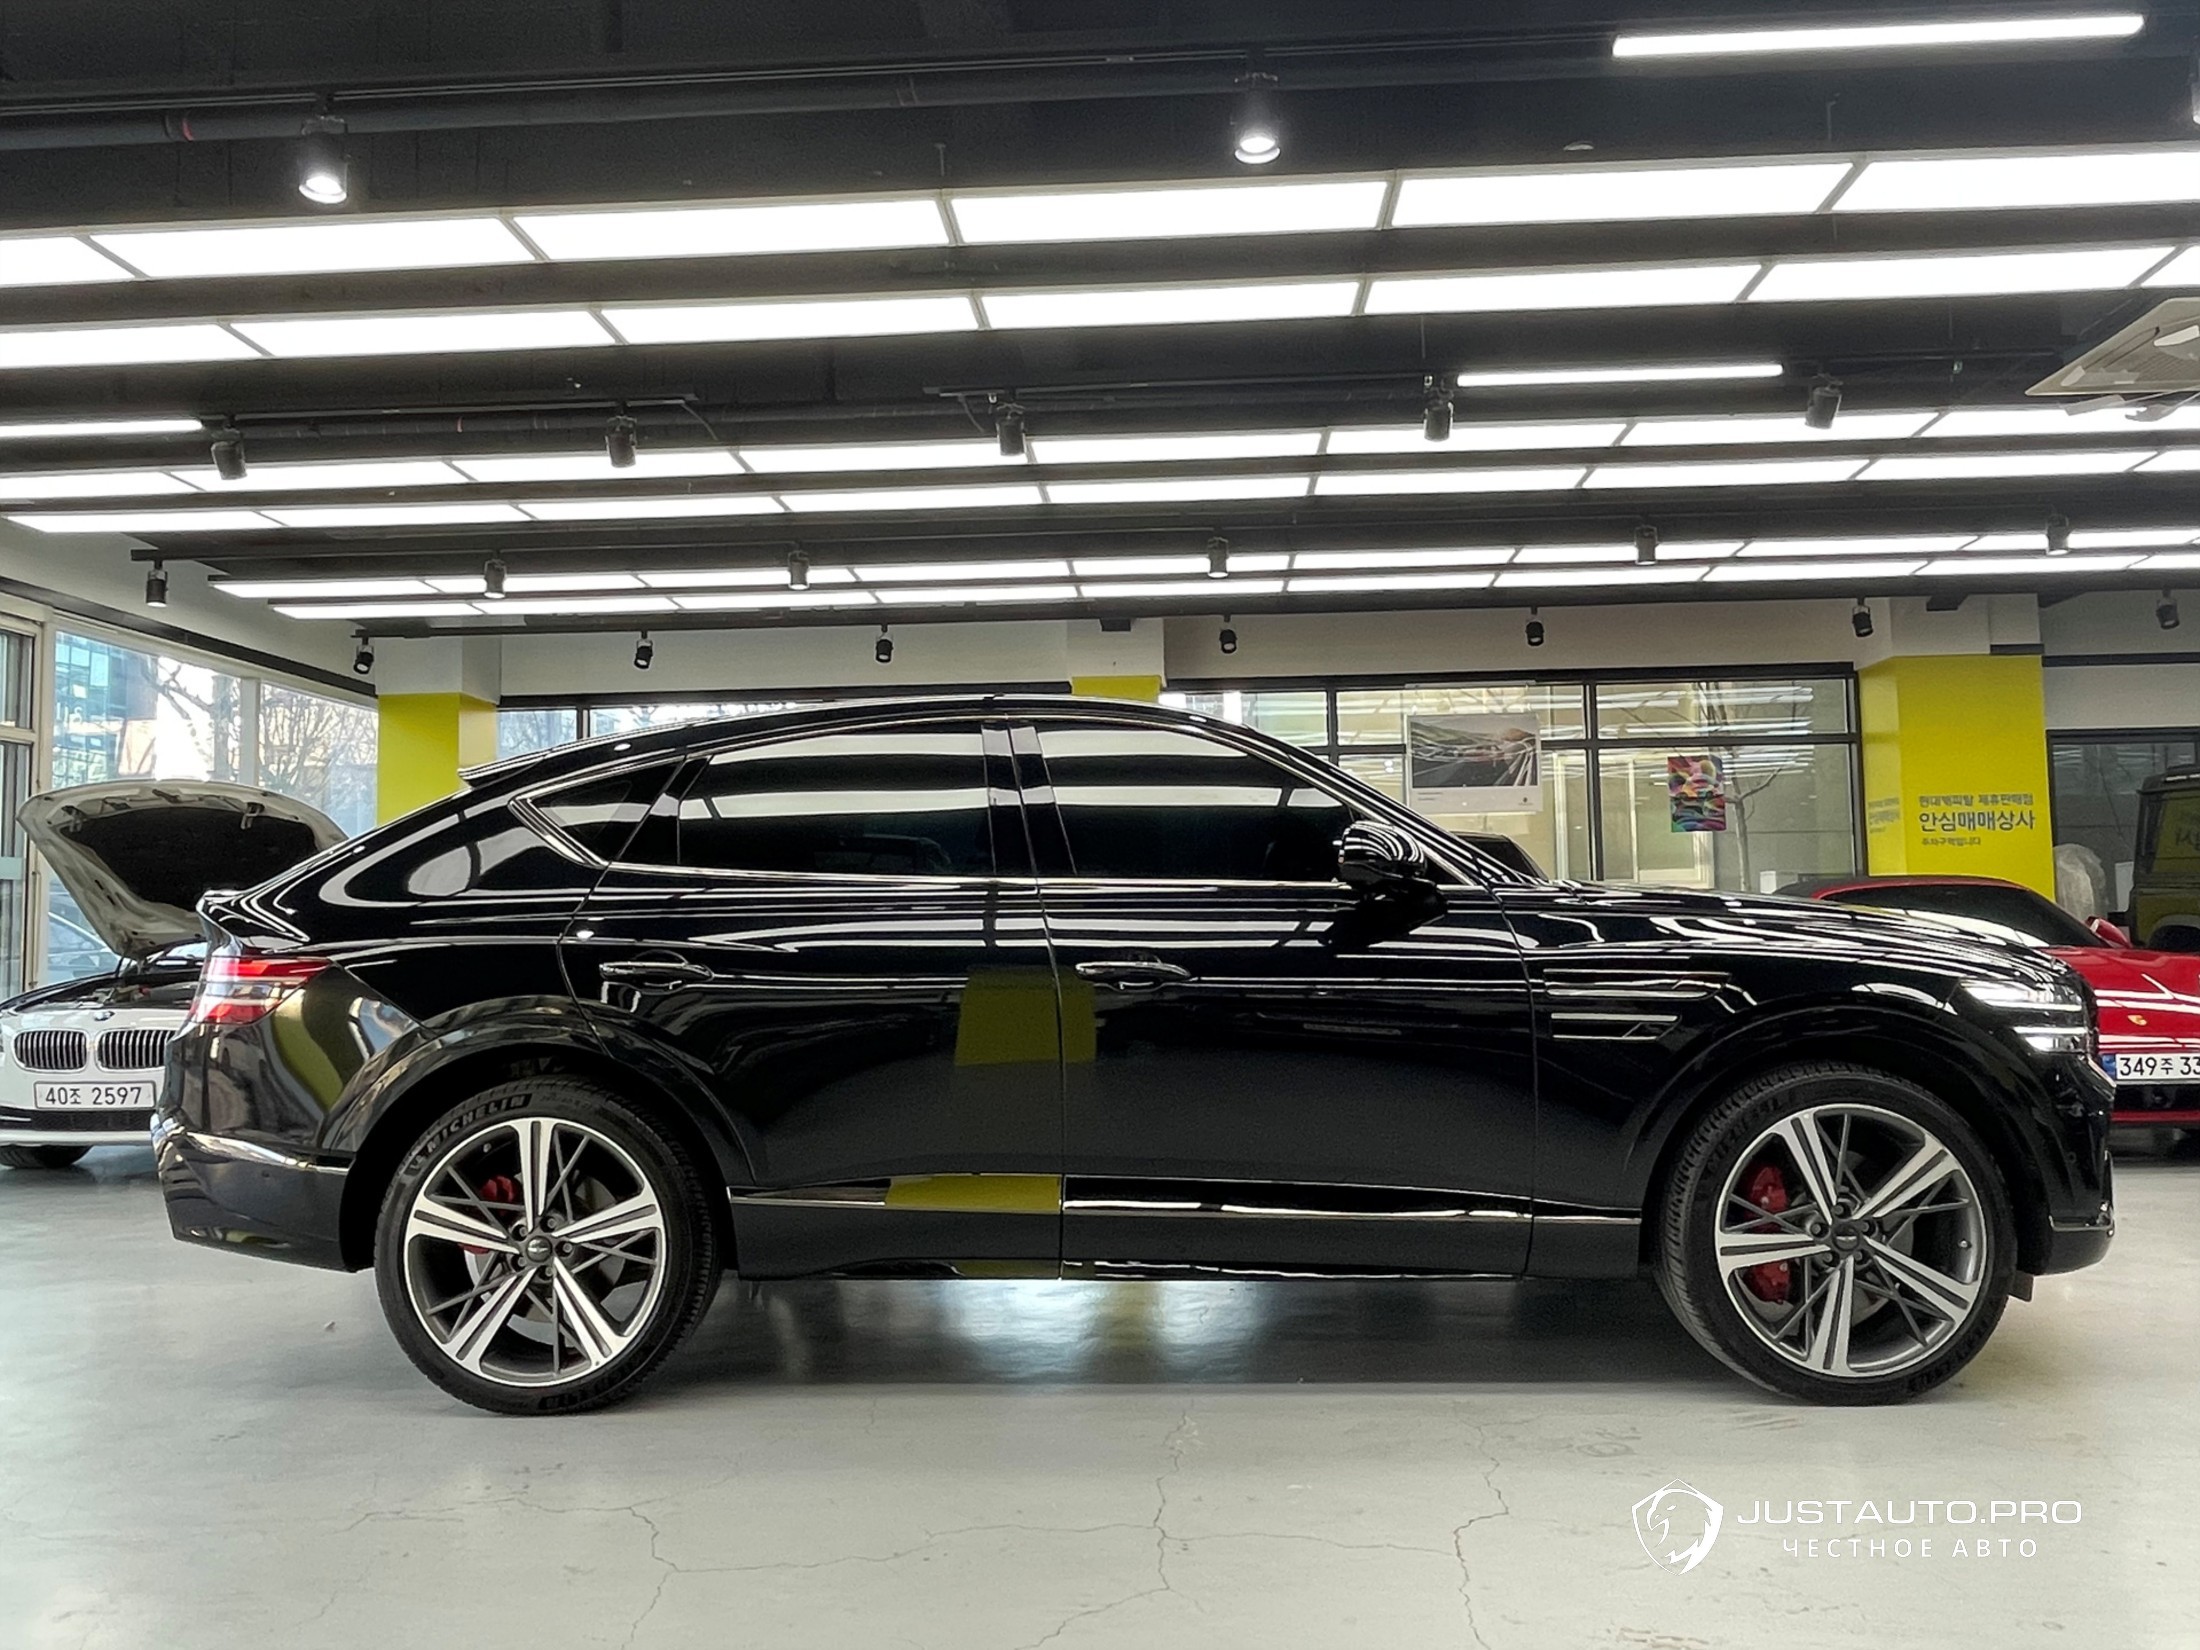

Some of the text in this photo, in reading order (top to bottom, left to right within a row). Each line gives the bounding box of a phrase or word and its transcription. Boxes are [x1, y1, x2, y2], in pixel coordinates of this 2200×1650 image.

[1919, 810, 2036, 832] 안심매매상사
[2120, 1057, 2173, 1075] 349주
[45, 1086, 142, 1105] 40조 2597
[426, 1095, 526, 1153] MICHELIN
